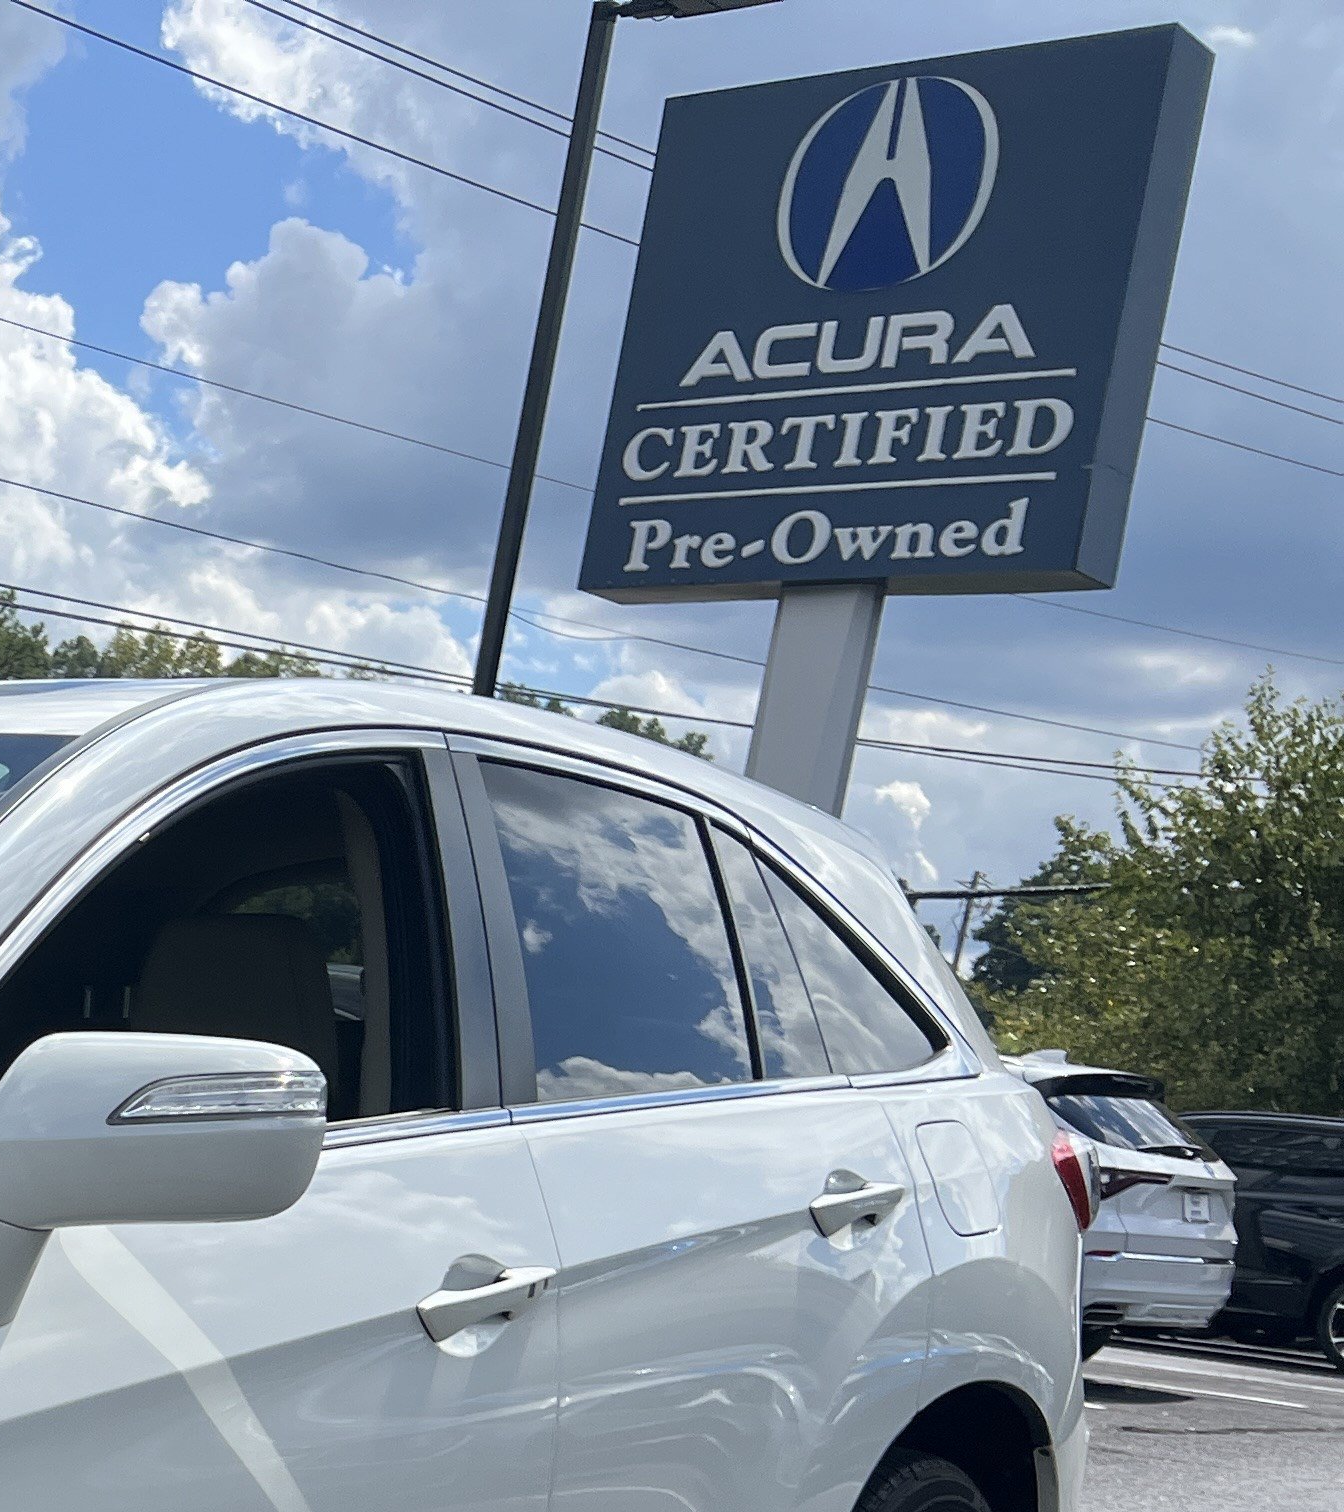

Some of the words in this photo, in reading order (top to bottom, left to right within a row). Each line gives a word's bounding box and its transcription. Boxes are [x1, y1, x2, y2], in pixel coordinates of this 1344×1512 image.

[679, 303, 1035, 387] ACURA
[621, 397, 1075, 482] CERTIFIED
[623, 496, 1030, 573] Pre-Owned
